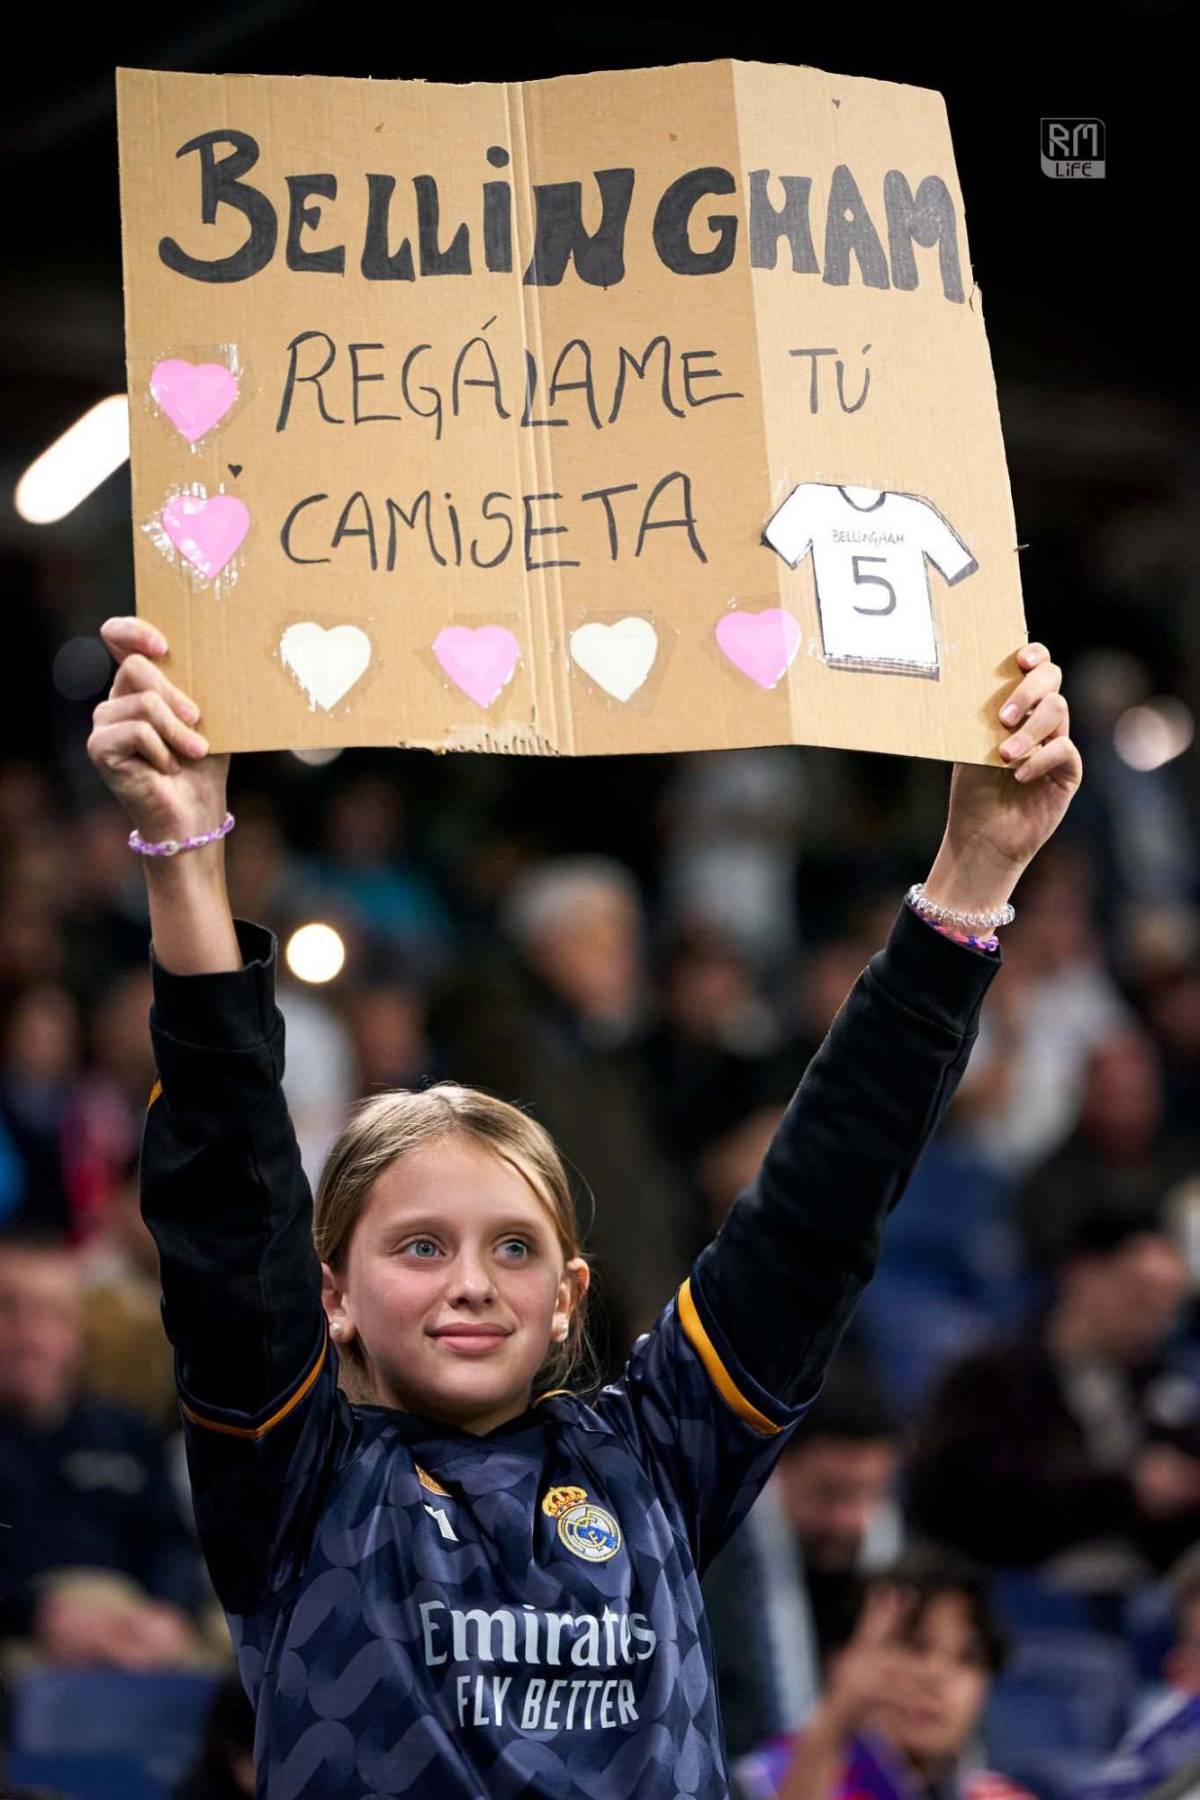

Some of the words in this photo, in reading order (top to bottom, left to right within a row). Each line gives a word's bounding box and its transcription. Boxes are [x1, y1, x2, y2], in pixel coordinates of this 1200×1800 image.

[276, 315, 744, 440] REGÁLAME
[789, 344, 872, 414] TÚ
[852, 556, 897, 616] 5
[419, 1600, 657, 1667] Emirates
[456, 1675, 512, 1727] FLY
[521, 1678, 639, 1730] BETTER
